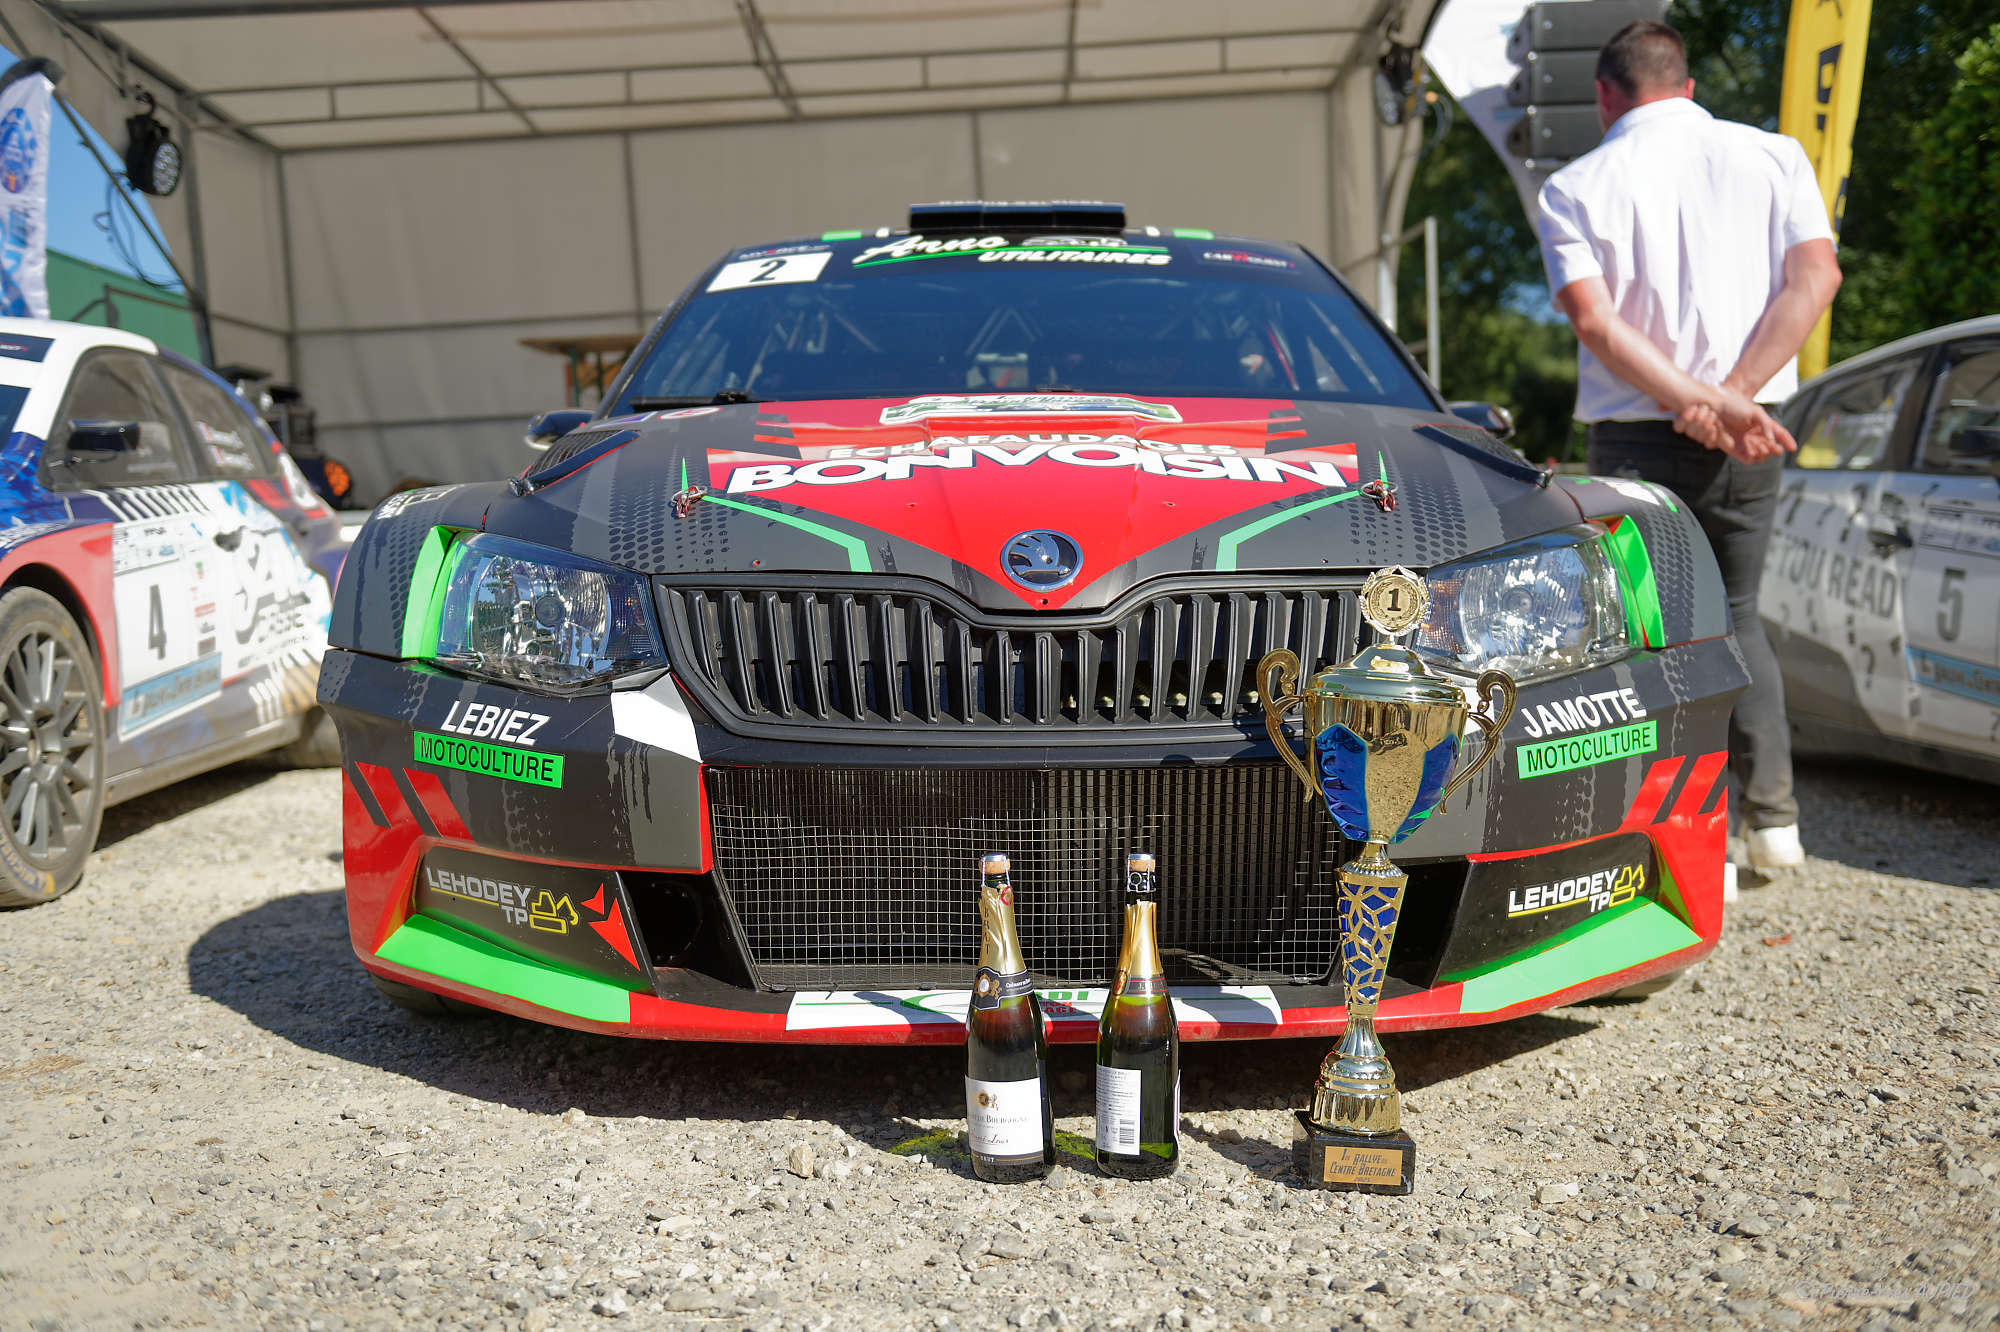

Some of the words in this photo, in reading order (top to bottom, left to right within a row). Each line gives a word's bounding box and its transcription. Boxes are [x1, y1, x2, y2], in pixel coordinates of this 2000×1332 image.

[750, 258, 788, 283] 2
[852, 235, 1009, 265] Anno
[978, 250, 1172, 266] UTILITAIRES
[828, 434, 1240, 459] ECHAFAUDAGES
[726, 443, 1347, 494] BONVOISIN
[1387, 588, 1402, 611] 1
[1936, 567, 1968, 642] 5
[148, 584, 167, 660] 4
[440, 700, 551, 746] LEBIEZ
[1521, 687, 1647, 739] JAMOTTE
[420, 737, 554, 782] MOTOCULTURE
[1526, 726, 1652, 773] MOTOCULTURE
[426, 866, 532, 907] LEHODEY
[1508, 867, 1618, 912] LEHODEY
[1588, 891, 1611, 913] TP
[501, 905, 529, 925] TP
[1329, 1161, 1356, 1175] CENTRE
[1358, 1162, 1397, 1177] BRETAGNE
